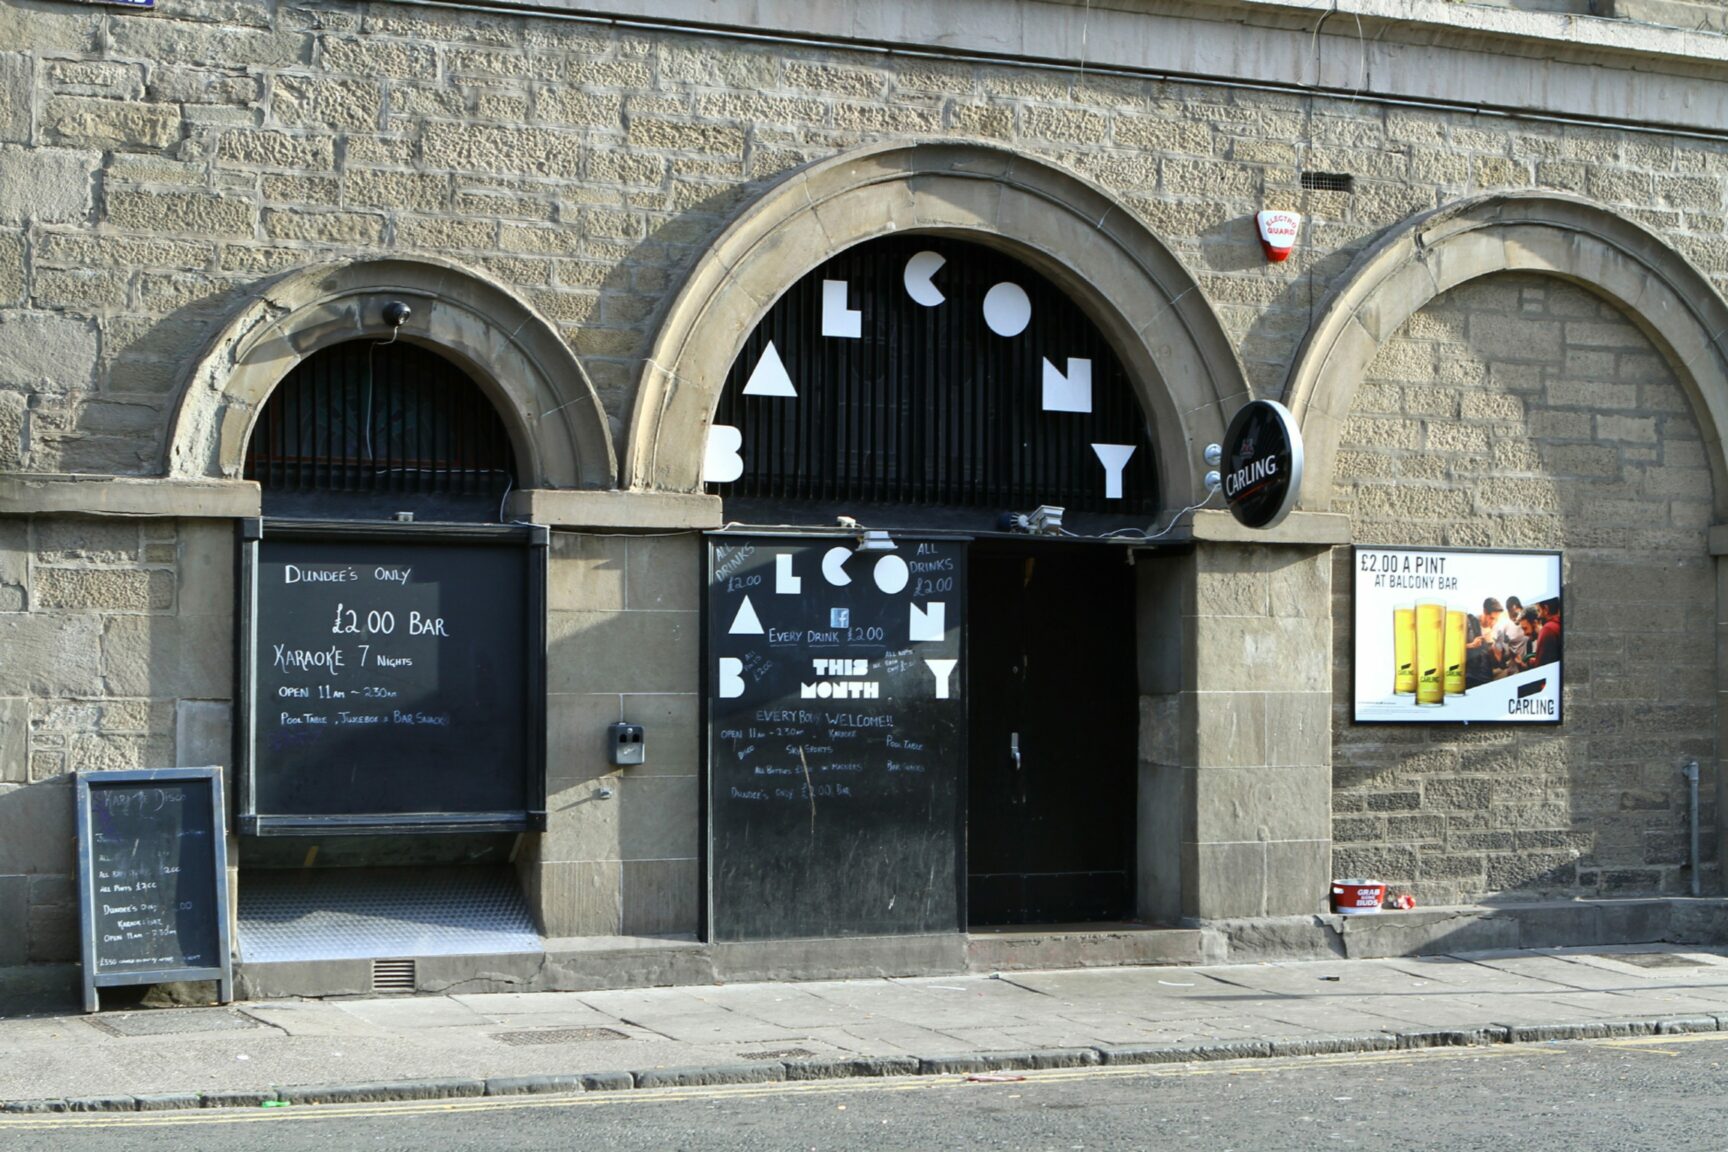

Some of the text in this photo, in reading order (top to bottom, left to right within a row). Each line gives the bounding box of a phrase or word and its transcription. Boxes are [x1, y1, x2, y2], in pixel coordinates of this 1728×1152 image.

[1266, 215, 1296, 228] ELECTRO
[1267, 227, 1295, 235] GUARD
[1226, 455, 1278, 496] CARLING
[716, 542, 735, 562] ALL
[916, 543, 938, 556] ALL
[715, 541, 755, 582] DRINKS
[910, 558, 953, 573] DRINKS
[1361, 554, 1446, 574] £2.00 A PINT
[285, 564, 411, 585] DUNDEE'S ONLY
[1375, 574, 1457, 590] AT BALCONY BAR
[409, 611, 450, 637] BAR
[769, 628, 802, 642] EVERY
[808, 630, 840, 642] DRINK
[273, 643, 413, 675] KARAOKE 7 NIGHTS
[812, 659, 868, 675] THIS
[279, 686, 309, 698] OPEN
[801, 681, 879, 698] MONTH
[1508, 699, 1555, 715] CARLING
[281, 712, 302, 725] POOL
[393, 710, 414, 725] BAR
[720, 729, 743, 739] OPEN
